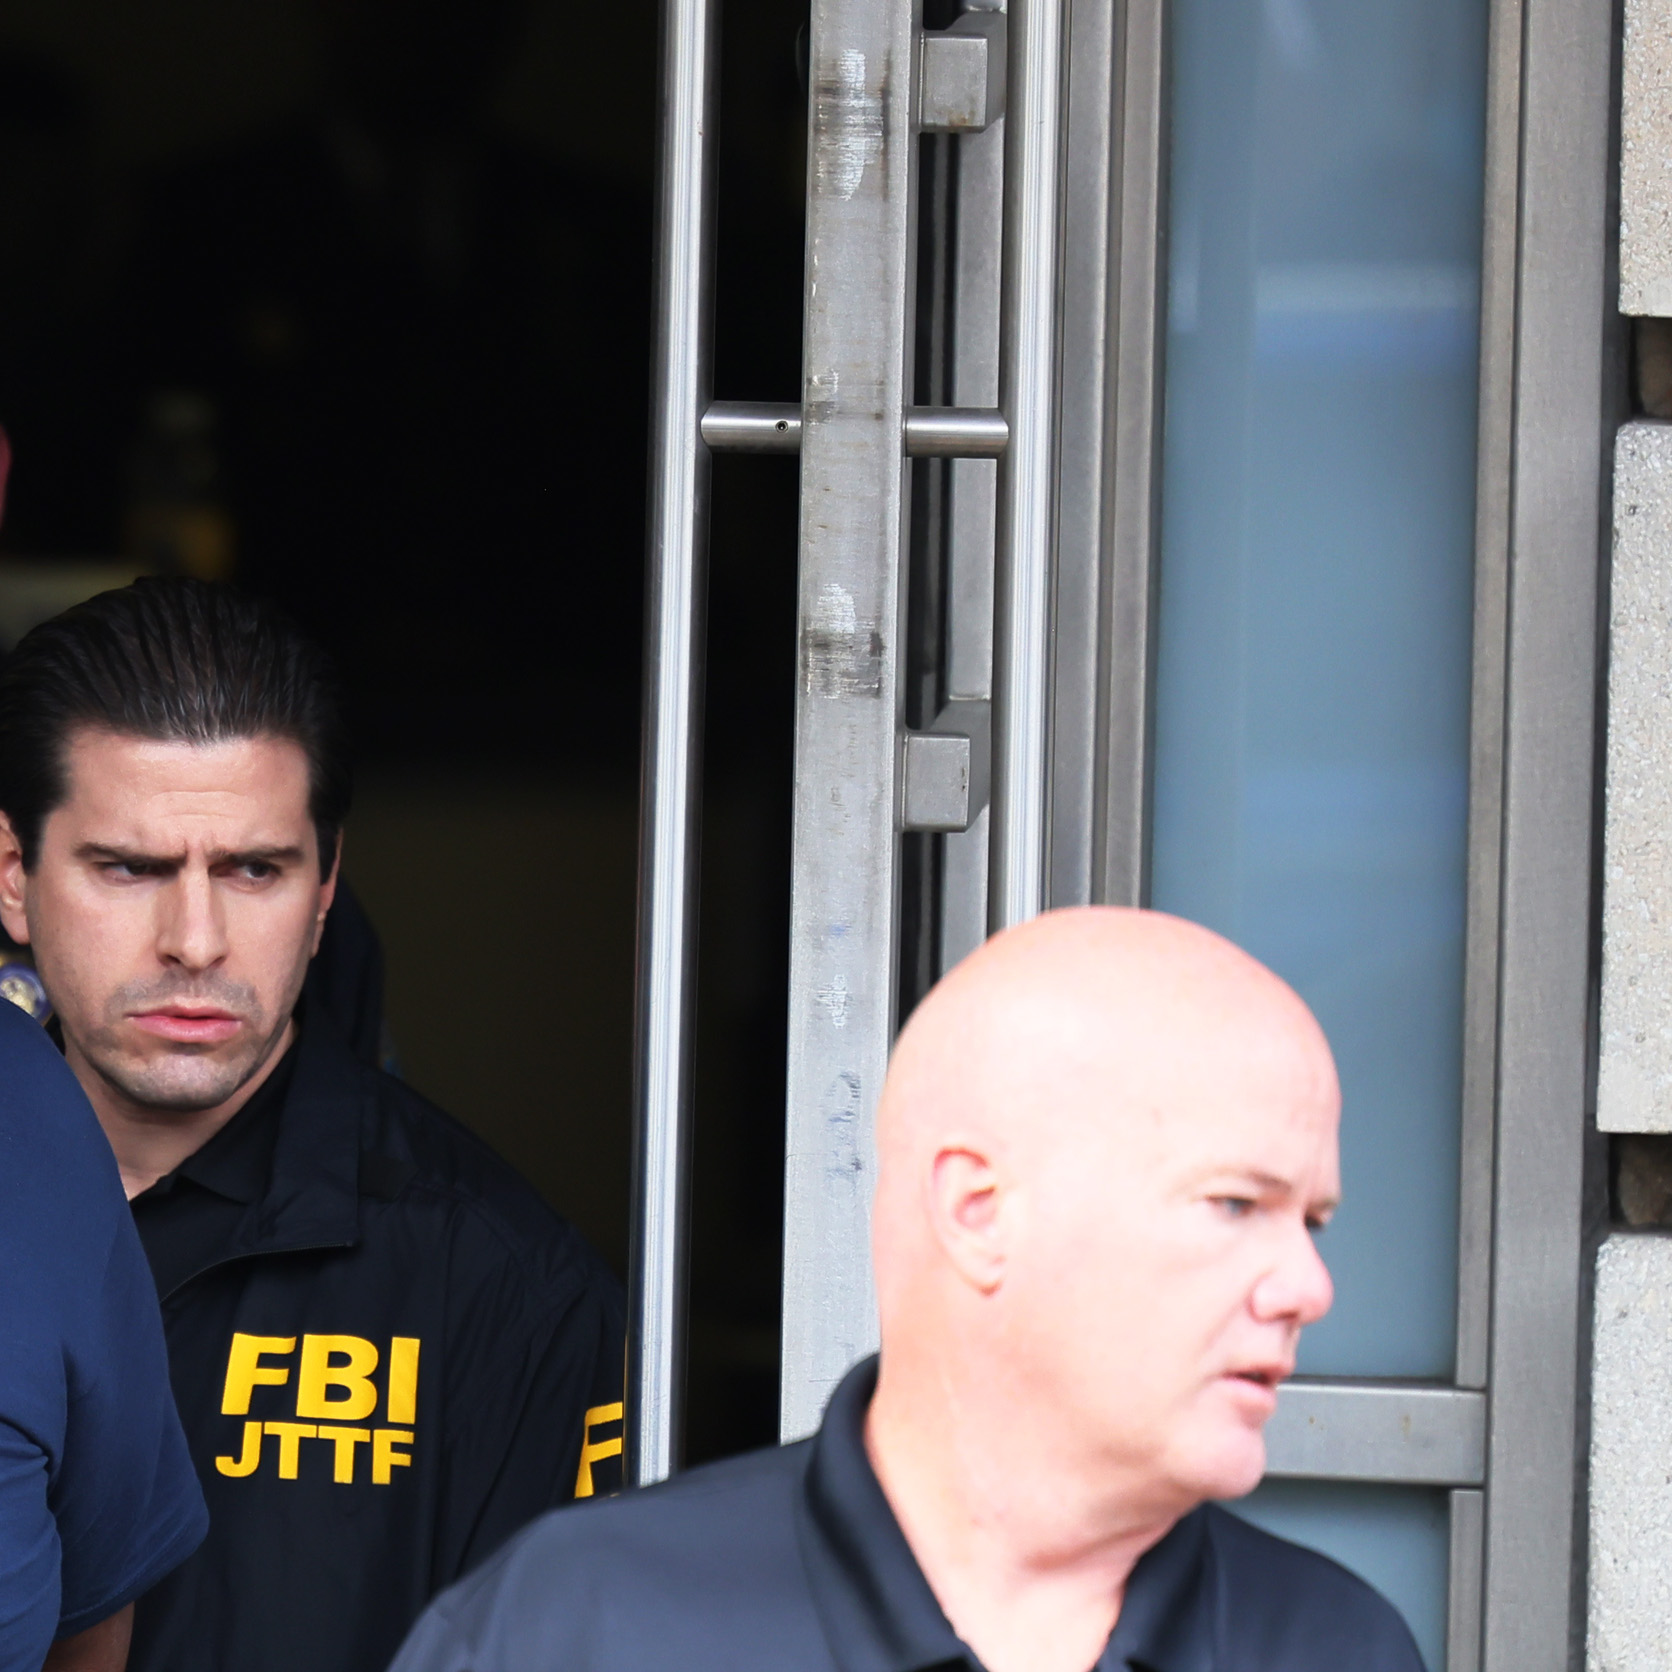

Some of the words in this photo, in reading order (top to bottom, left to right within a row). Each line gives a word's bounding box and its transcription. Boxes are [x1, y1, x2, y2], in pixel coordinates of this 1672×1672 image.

[220, 1332, 422, 1425] FBI
[215, 1421, 415, 1486] JTTF
[574, 1401, 623, 1499] F
